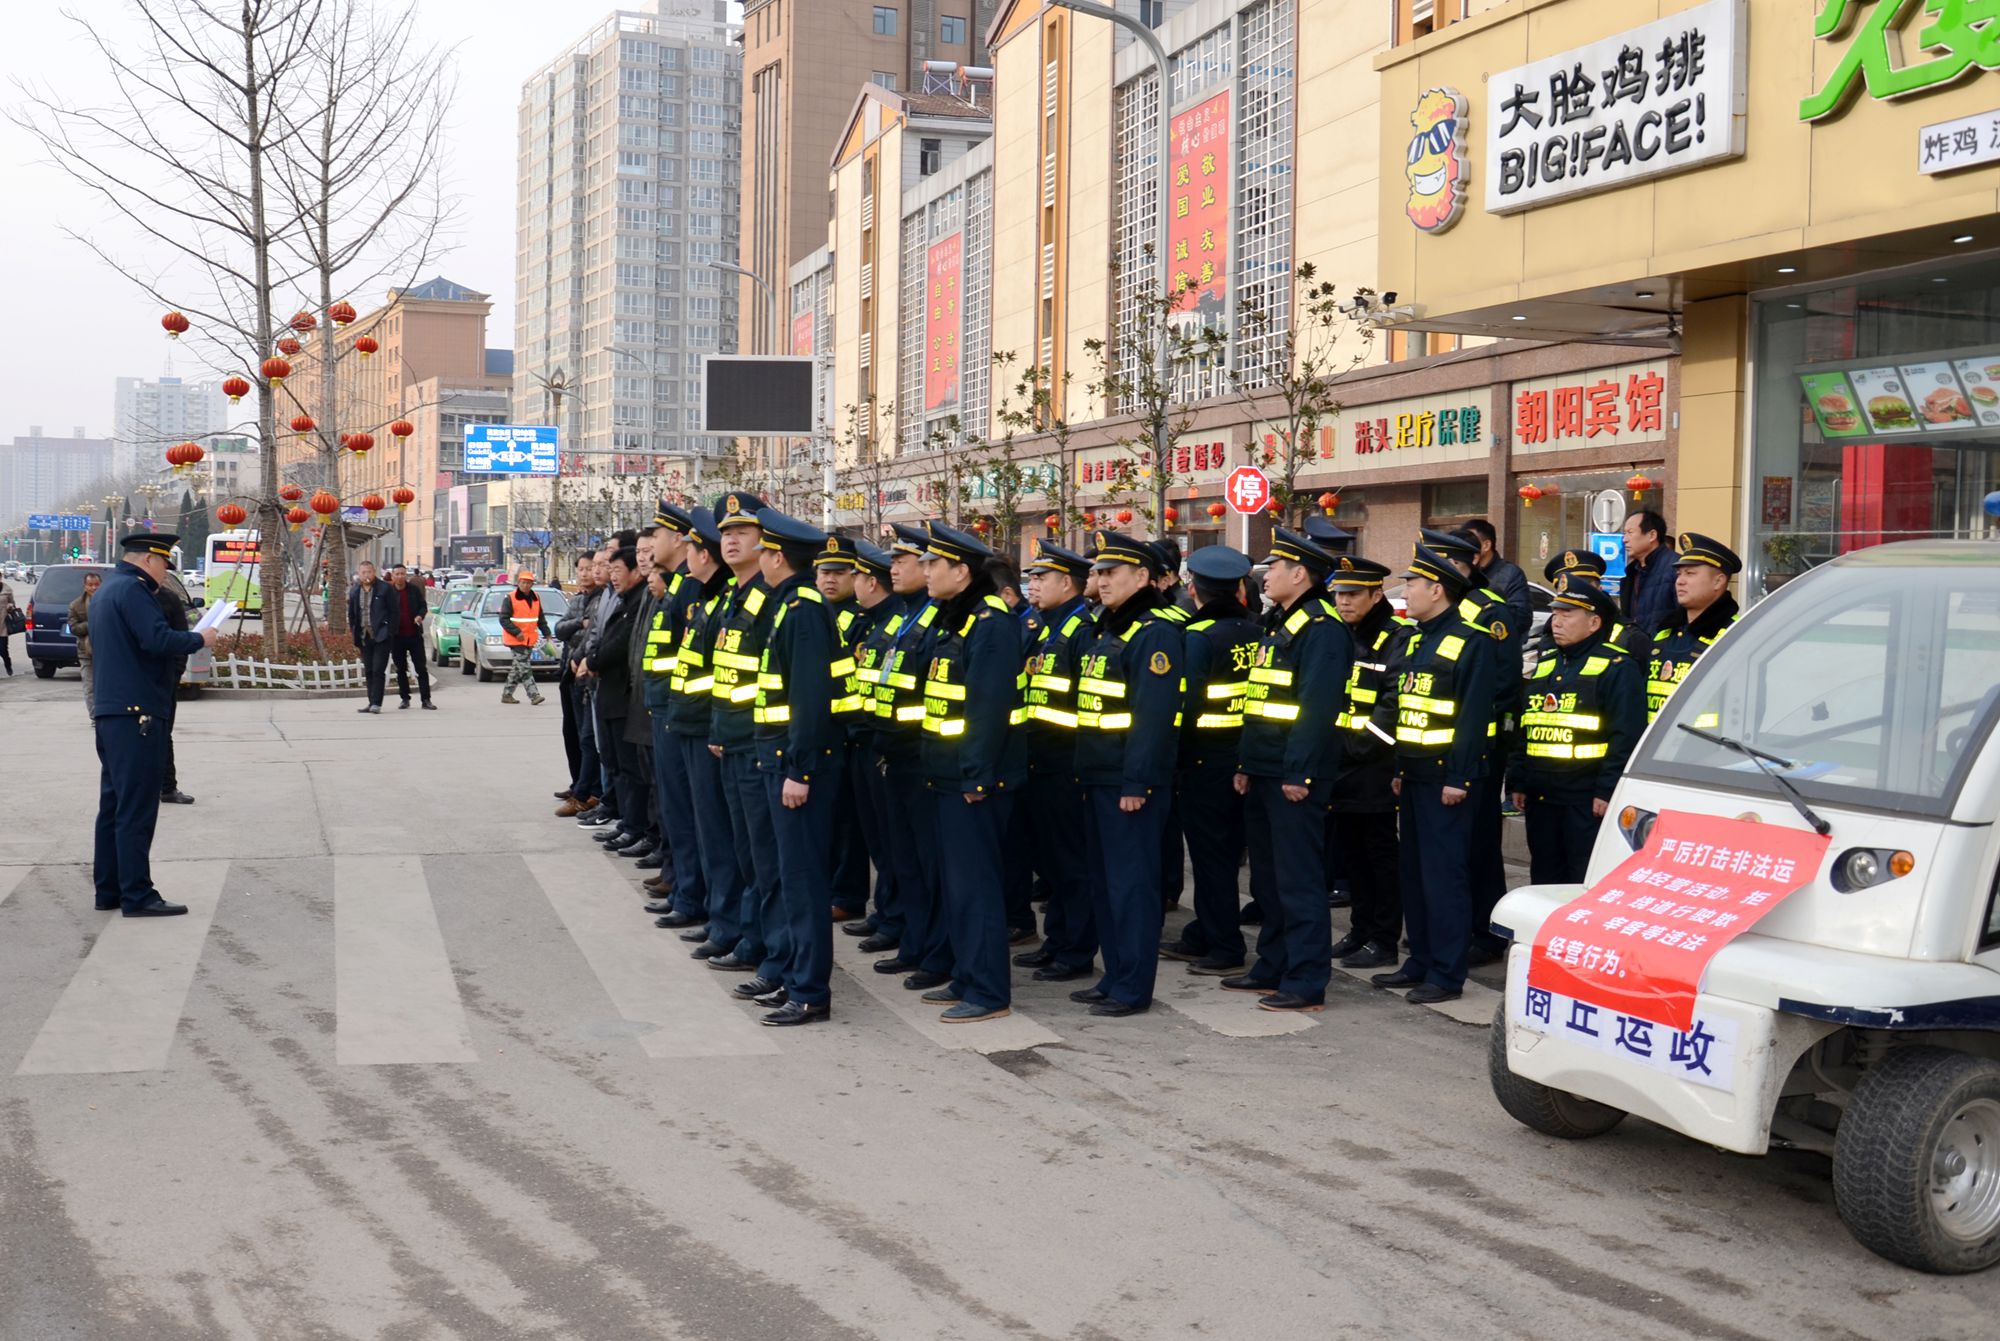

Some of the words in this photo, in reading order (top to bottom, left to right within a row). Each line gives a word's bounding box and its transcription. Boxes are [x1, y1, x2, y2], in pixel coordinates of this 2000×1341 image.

[1499, 27, 1706, 138] 大脸鸡排
[1499, 92, 1706, 195] BIG!FACE!
[1924, 127, 1978, 164] 炸鸡
[1515, 371, 1664, 444] 朝阳宾馆
[1354, 404, 1482, 455] 洗头足疗保健
[1232, 474, 1262, 506] 停
[1599, 541, 1619, 561] P
[1648, 659, 1691, 682] 交通
[1525, 692, 1578, 713] 交通
[1655, 838, 1796, 884] 严厉打击非法运
[1545, 935, 1627, 978] 经营行为。
